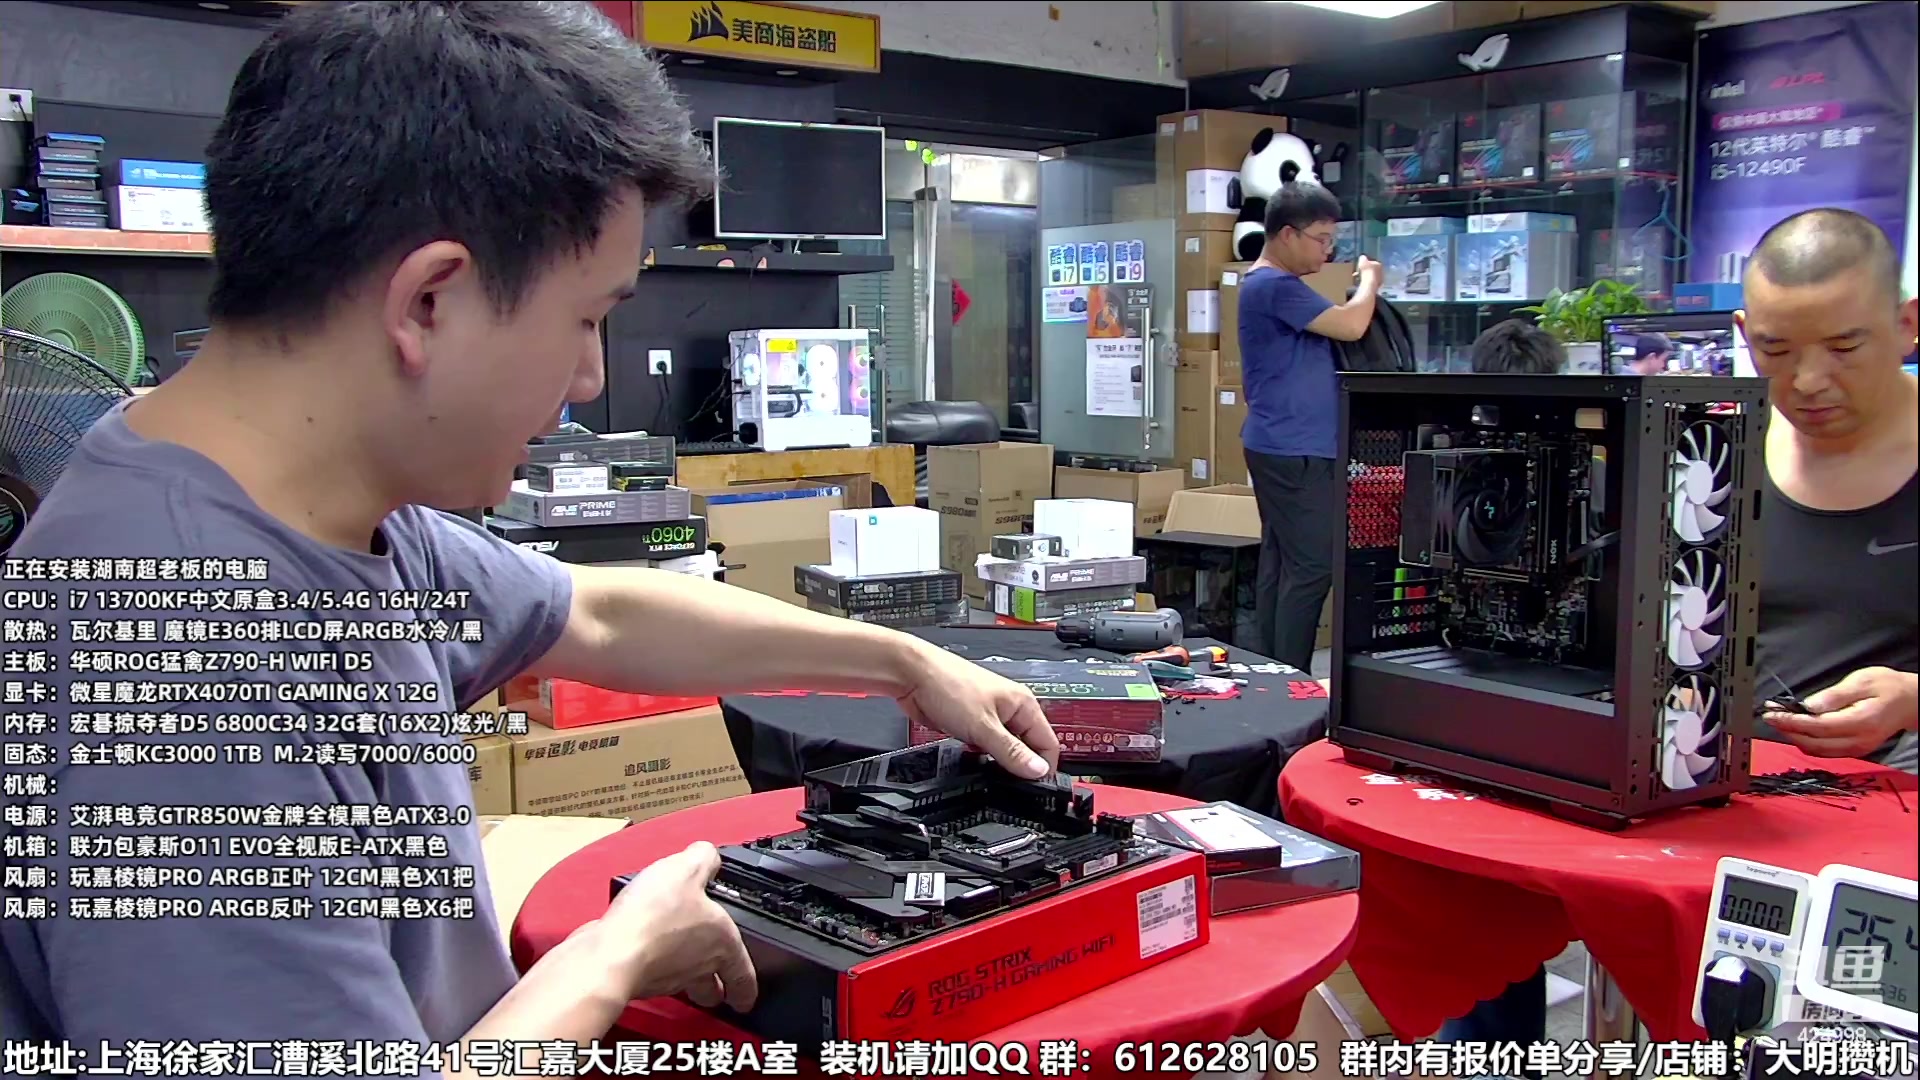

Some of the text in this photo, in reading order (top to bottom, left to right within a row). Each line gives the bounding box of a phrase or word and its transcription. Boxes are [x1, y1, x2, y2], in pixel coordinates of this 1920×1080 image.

[733, 18, 836, 53] 美商海盗船
[1710, 156, 1807, 180] i5-12490F
[1129, 262, 1142, 280] i9
[579, 500, 616, 510] PRIME
[928, 949, 1033, 999] ROG STRIX
[1012, 951, 1079, 986] GAMING
[1081, 933, 1116, 959] WIFI
